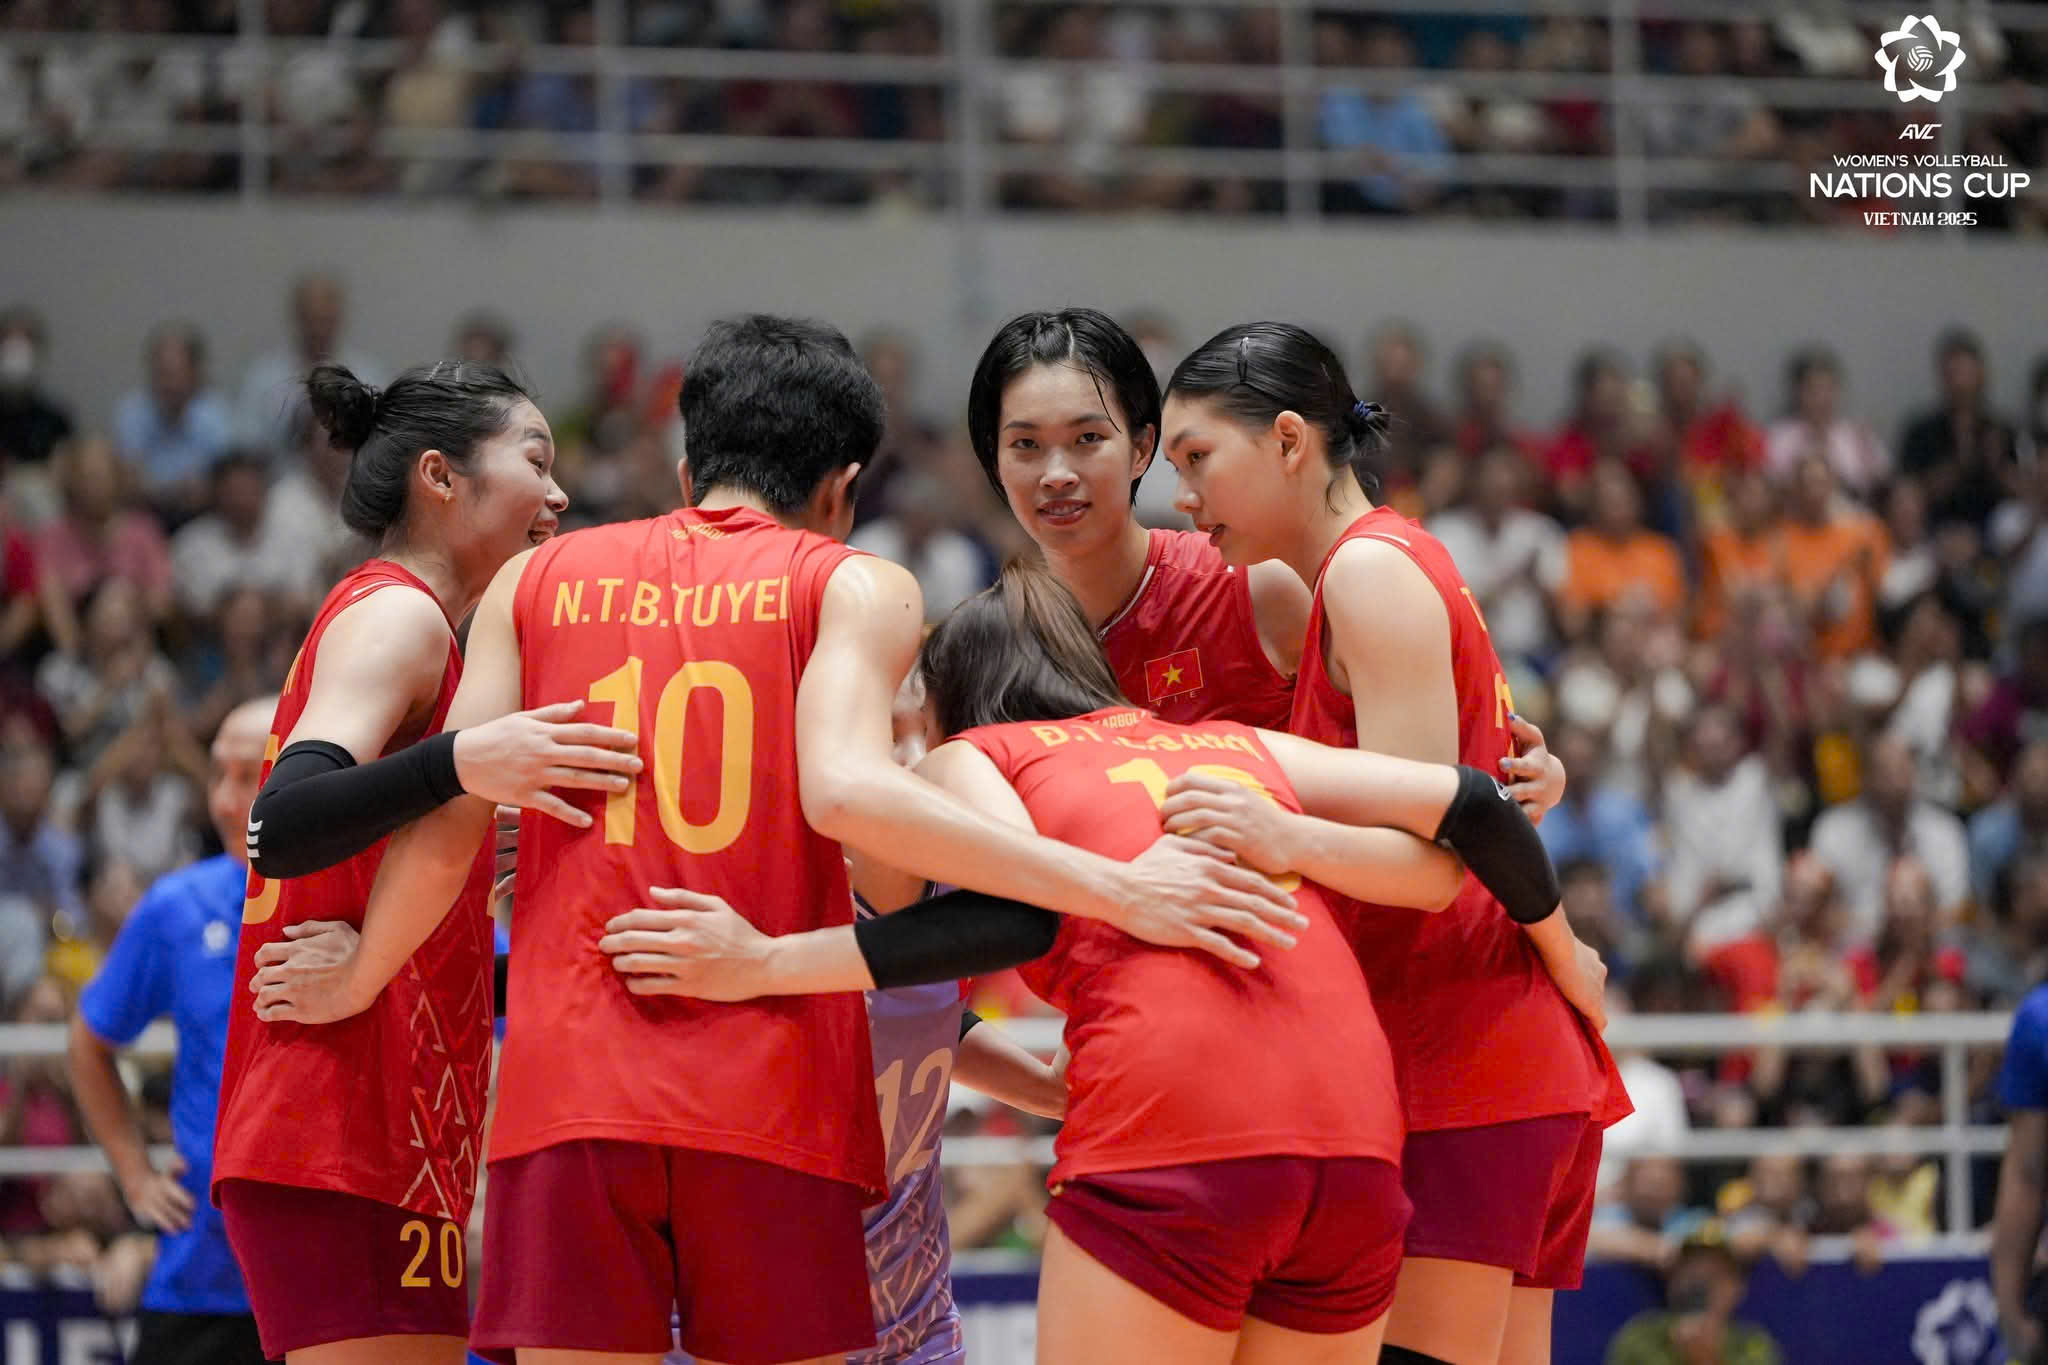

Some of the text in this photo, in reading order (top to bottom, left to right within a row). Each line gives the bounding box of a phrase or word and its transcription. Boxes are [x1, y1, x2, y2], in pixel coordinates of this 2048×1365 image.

[588, 655, 755, 855] 10
[874, 1047, 954, 1185] 12
[399, 1219, 464, 1289] 20
